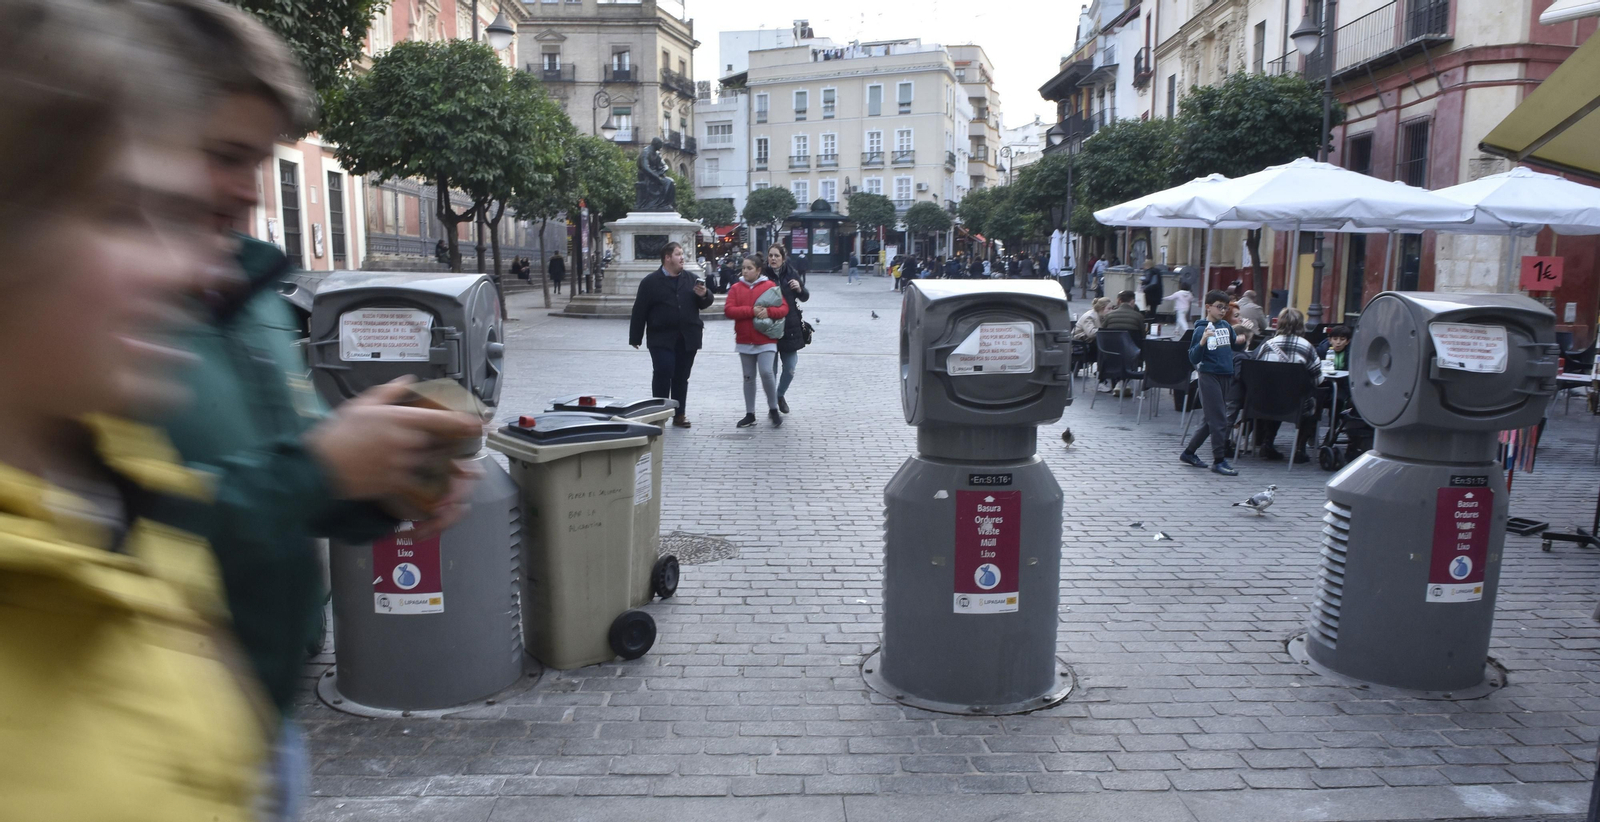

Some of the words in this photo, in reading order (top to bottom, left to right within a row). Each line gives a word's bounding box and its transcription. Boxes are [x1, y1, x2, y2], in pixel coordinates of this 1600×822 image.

[1533, 261, 1557, 282] 1€
[974, 516, 1003, 524] Ordures
[981, 538, 996, 546] Müll
[397, 549, 413, 557] Lixo
